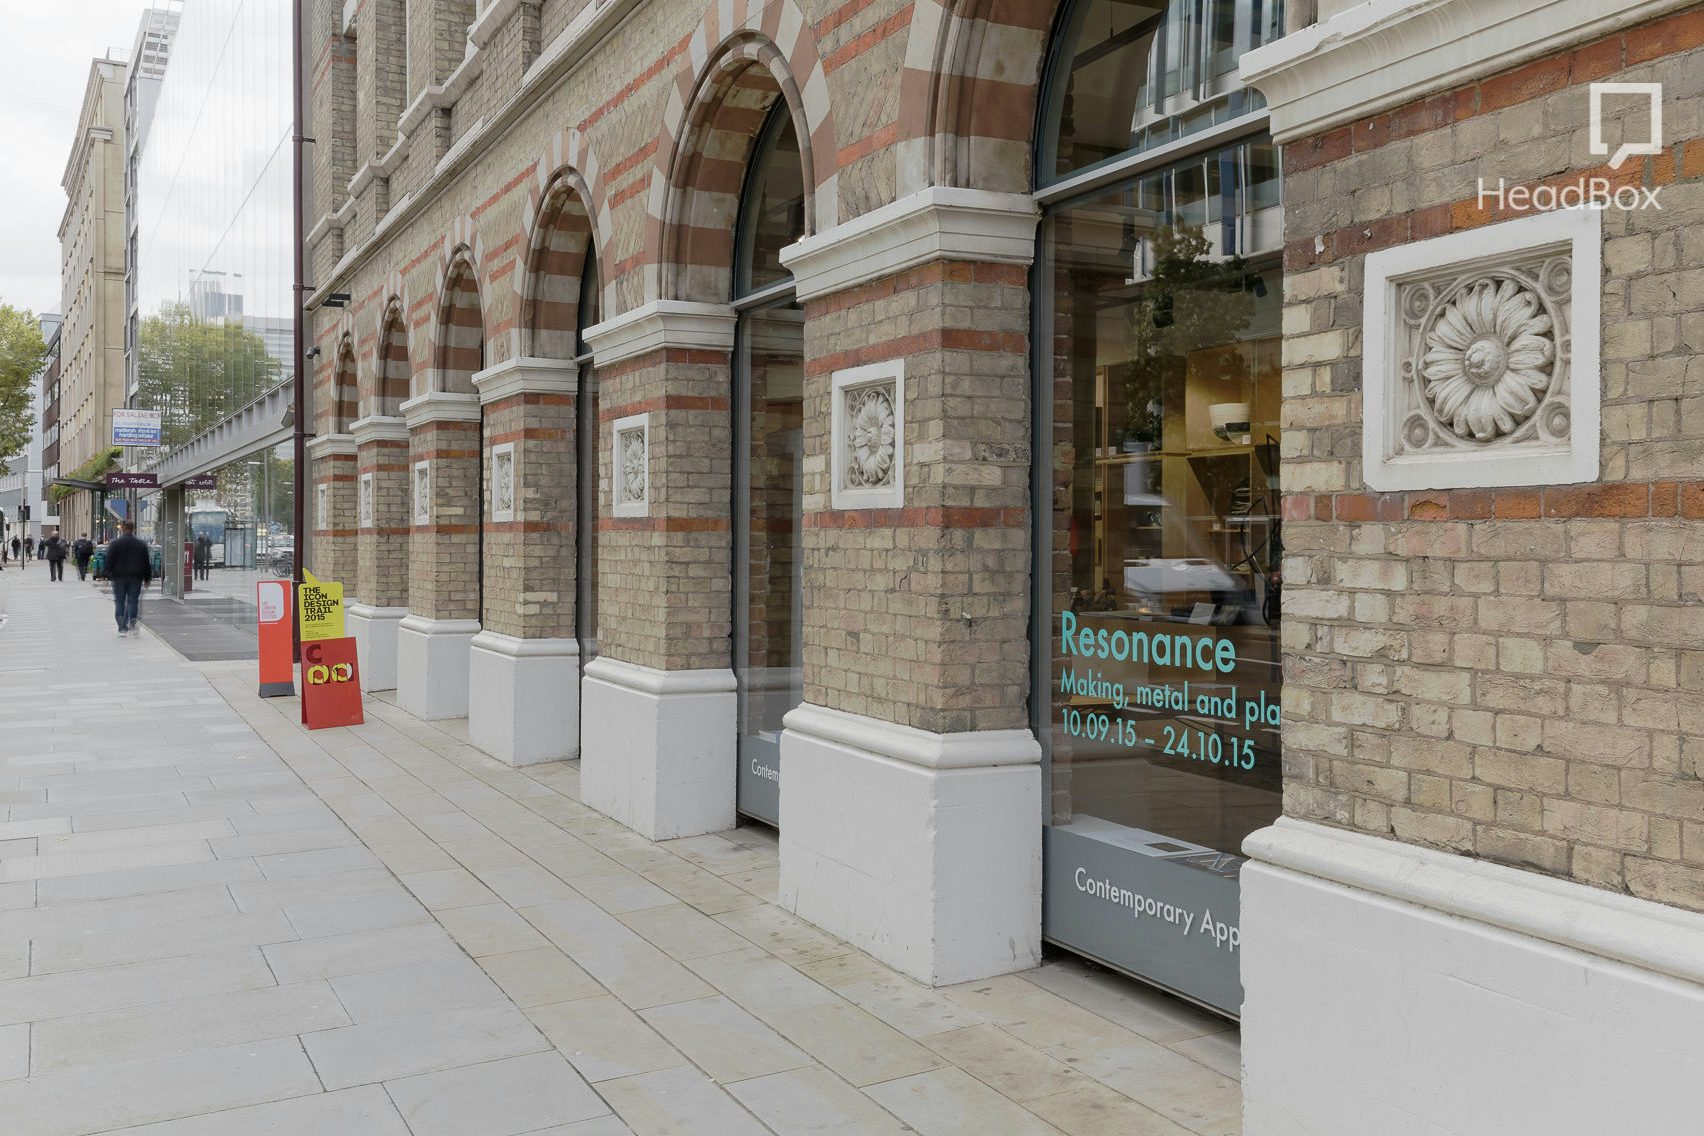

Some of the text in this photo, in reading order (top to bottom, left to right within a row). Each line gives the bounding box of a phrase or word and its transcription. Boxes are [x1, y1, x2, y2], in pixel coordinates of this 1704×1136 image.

[303, 586, 321, 594] THE
[303, 593, 328, 601] ICON
[304, 599, 339, 608] DESIGN
[304, 606, 333, 615] TRAIL
[304, 613, 326, 622] 2015
[1061, 610, 1236, 673] Resonance
[1060, 666, 1281, 731] Making, metal and pla
[1061, 708, 1136, 747] 10.09.15
[1163, 725, 1255, 770] 24.10.15
[751, 758, 780, 782] Contem
[1074, 866, 1241, 953] Contemporary App
